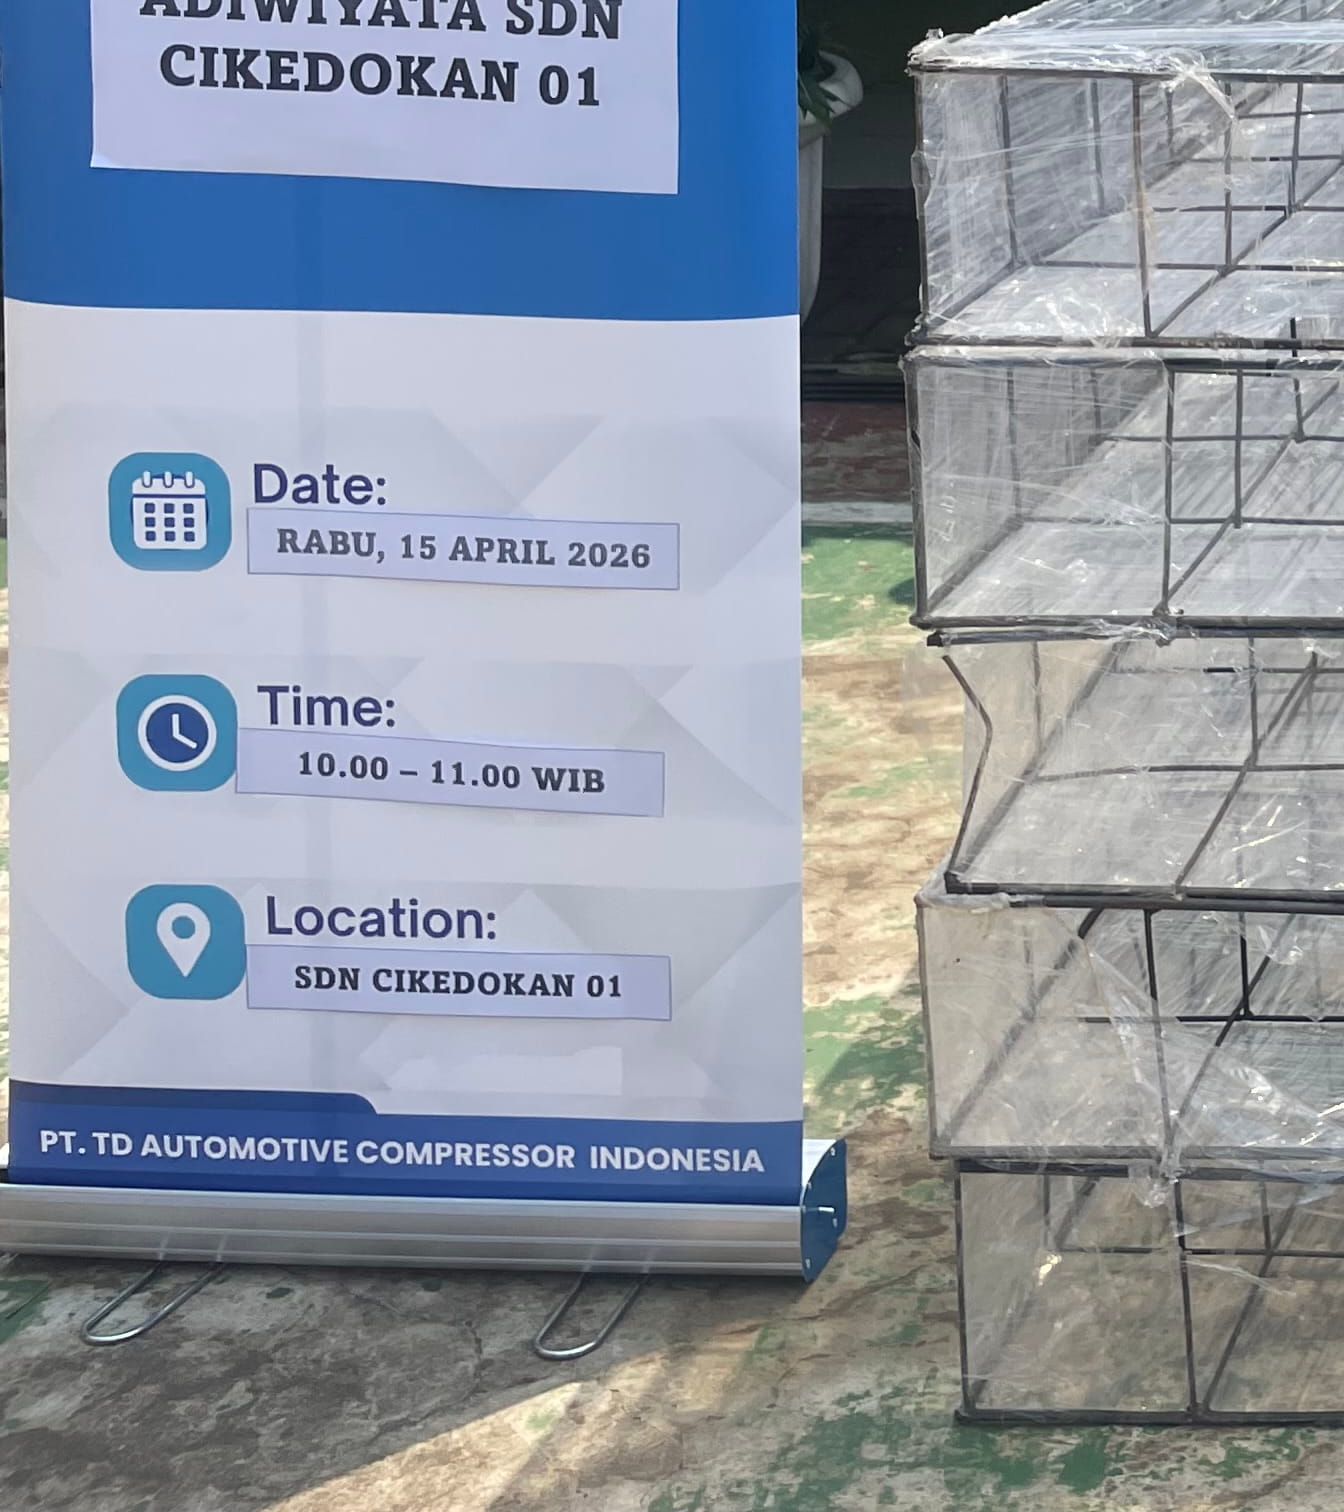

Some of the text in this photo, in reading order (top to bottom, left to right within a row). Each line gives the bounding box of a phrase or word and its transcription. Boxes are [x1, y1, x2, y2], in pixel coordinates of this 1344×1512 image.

[160, 43, 600, 106] CIKEDOKAN 01
[253, 463, 387, 505] Date:
[276, 528, 651, 569] RABU, 15 APRIL 2026
[257, 684, 396, 727] Time:
[299, 752, 388, 781] 10.00
[431, 760, 521, 789] 11.00
[532, 766, 605, 793] WIB
[265, 895, 497, 940] Location:
[294, 964, 622, 999] SDN CIKEDOKAN 01
[40, 1129, 764, 1174] PT. TD AUTOMOTIVE COMPRESSOR INDONESIA
